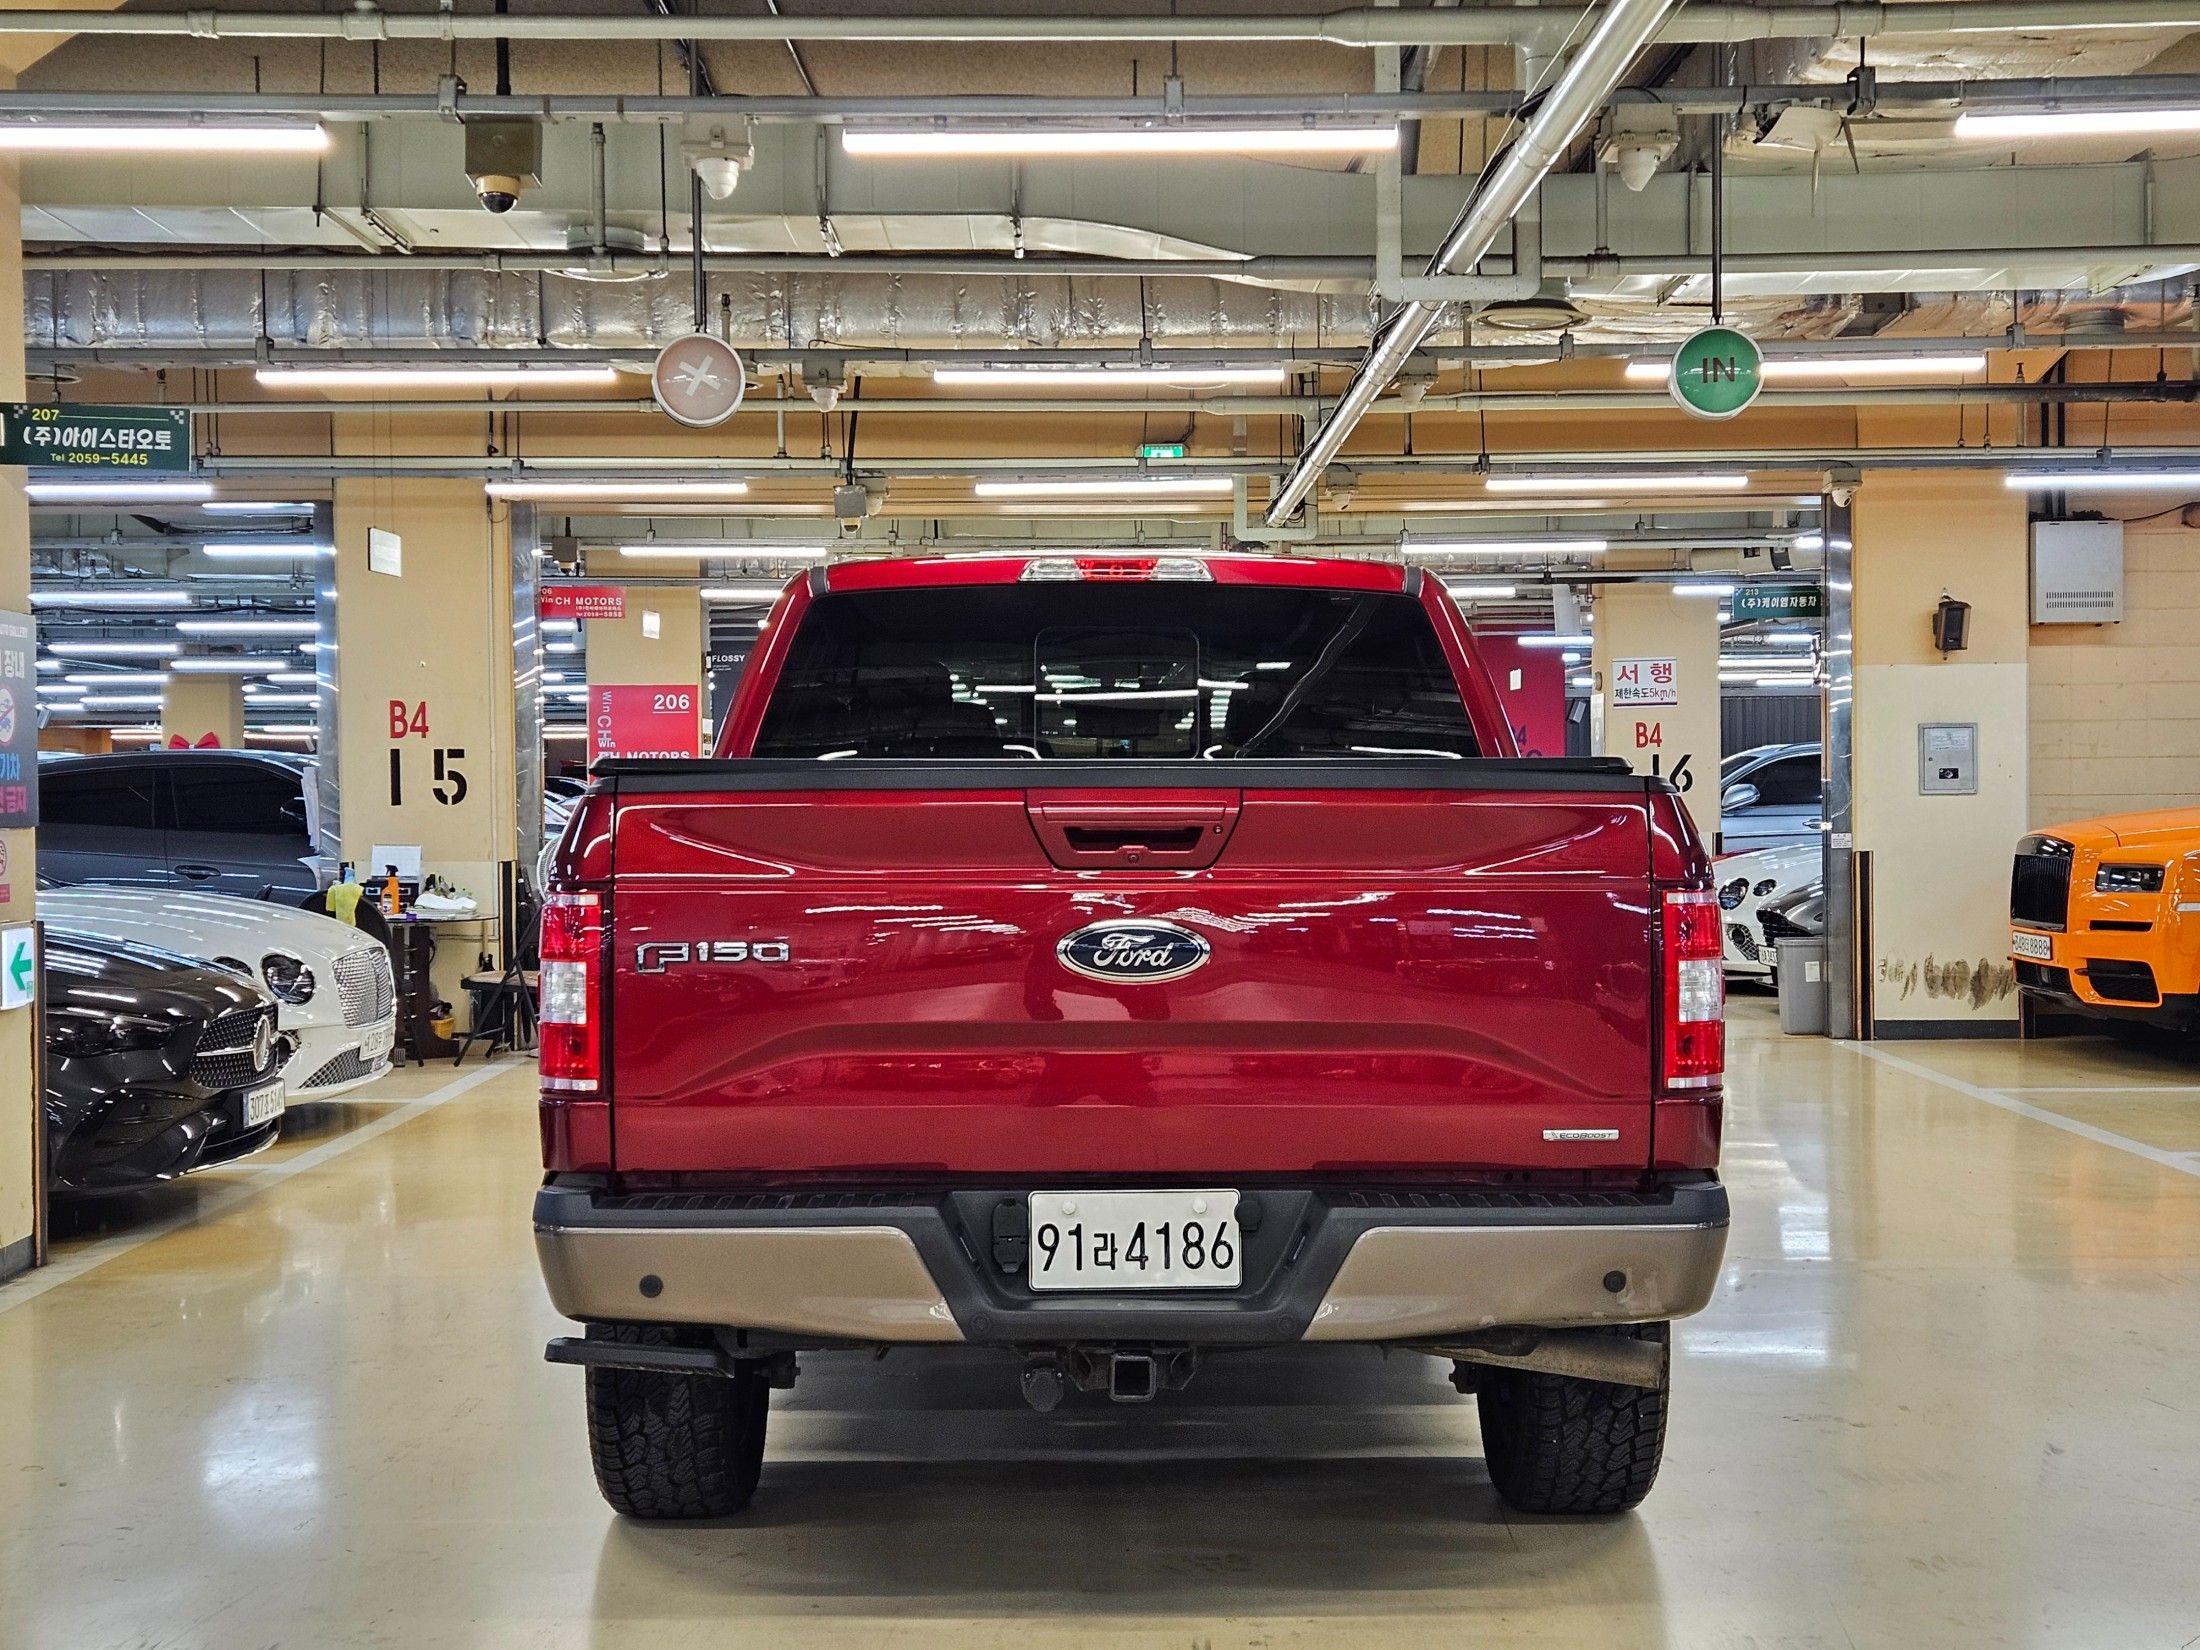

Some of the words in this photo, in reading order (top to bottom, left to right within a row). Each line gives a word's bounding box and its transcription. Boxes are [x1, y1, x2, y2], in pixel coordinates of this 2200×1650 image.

[1702, 356, 1736, 384] IN
[31, 408, 60, 421] 207
[22, 426, 172, 451] (주)아이스타오토
[51, 453, 65, 462] Tel
[68, 452, 149, 465] 2059-5445
[575, 596, 622, 606] MOTORS
[1745, 588, 1759, 596] 213
[711, 654, 745, 663] FLOSSY
[653, 693, 690, 710] 206
[389, 700, 429, 738] B4
[1635, 722, 1662, 748] B4
[1092, 932, 1174, 967] Ford
[1037, 1221, 1234, 1272] 91라4186
